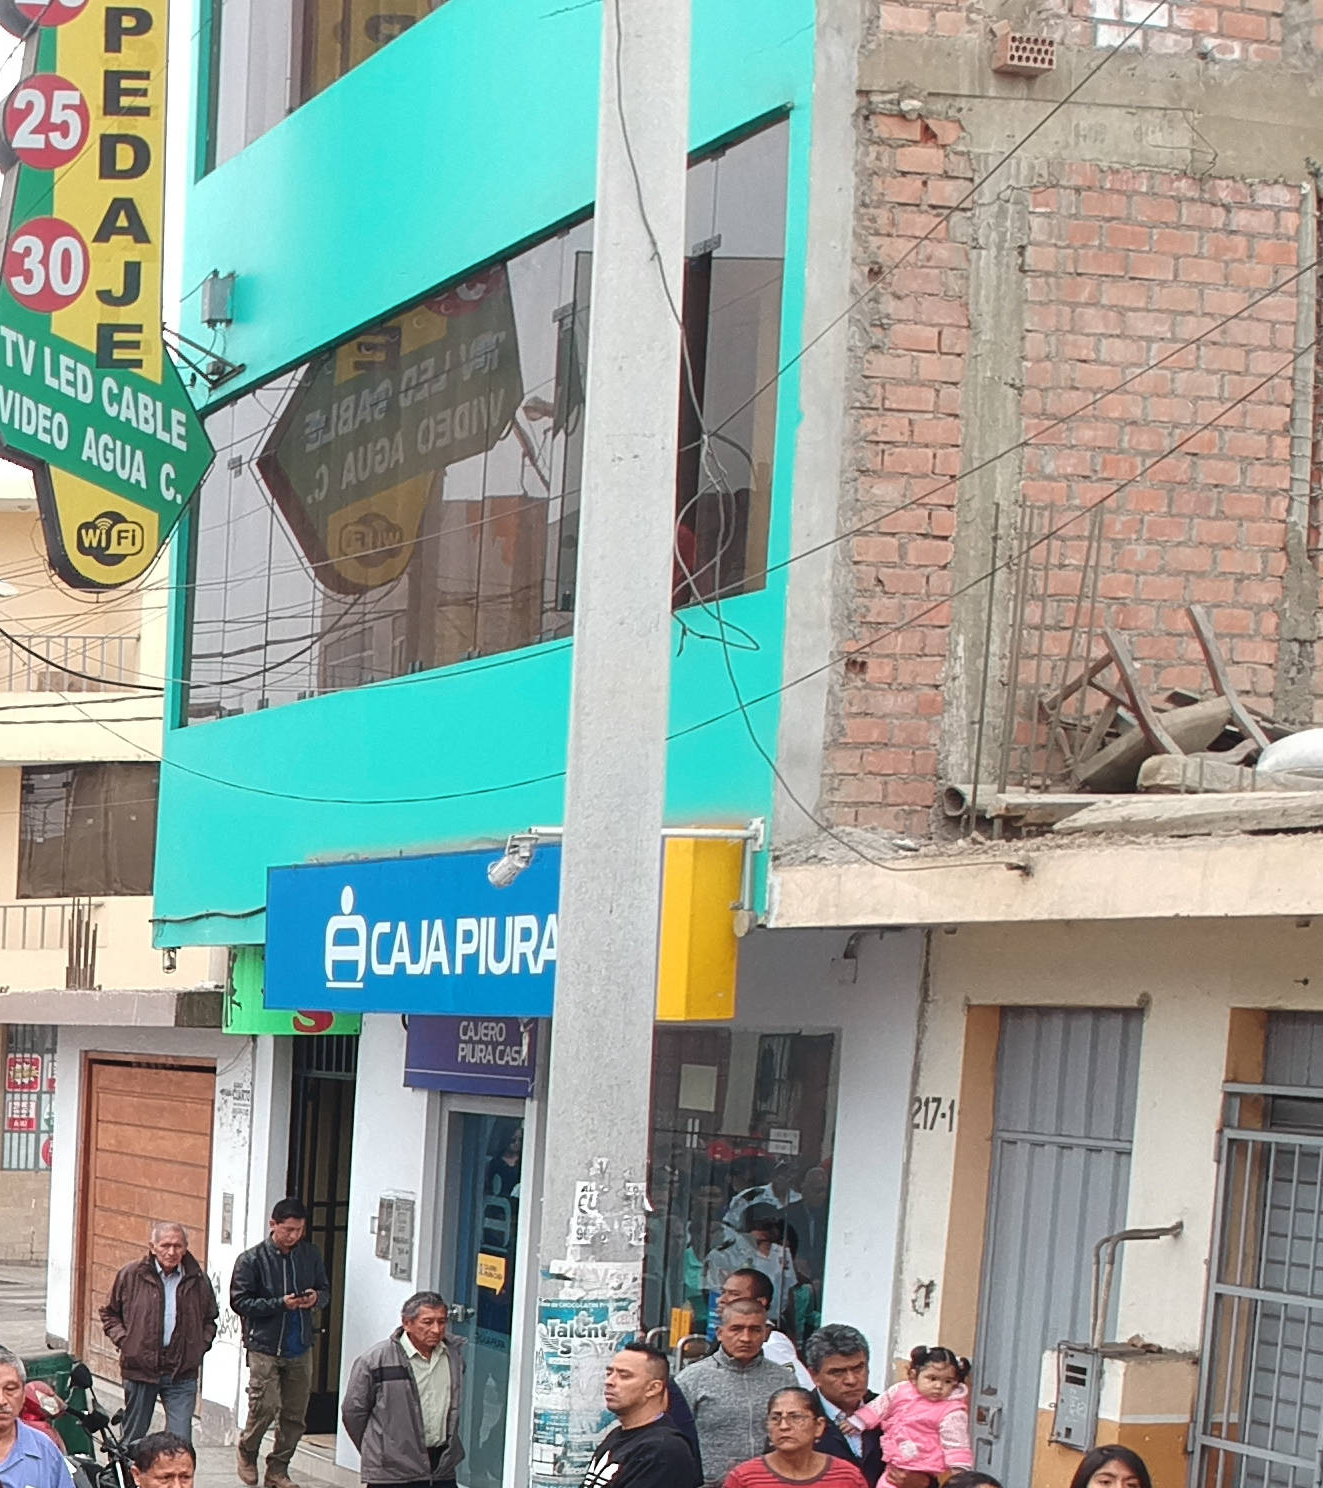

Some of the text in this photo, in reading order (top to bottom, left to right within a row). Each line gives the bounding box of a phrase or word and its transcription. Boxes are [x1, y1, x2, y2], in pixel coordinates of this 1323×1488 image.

[11, 89, 83, 151] 25
[10, 235, 84, 297] 30
[0, 326, 189, 453] TV LED CABLE
[81, 427, 148, 490] AGUA
[159, 463, 182, 506] C.
[371, 913, 557, 975] CAJA PIURA
[457, 1044, 529, 1067] PIURA CASH
[459, 1020, 506, 1042] CAJERO
[912, 1096, 955, 1133] 217-1
